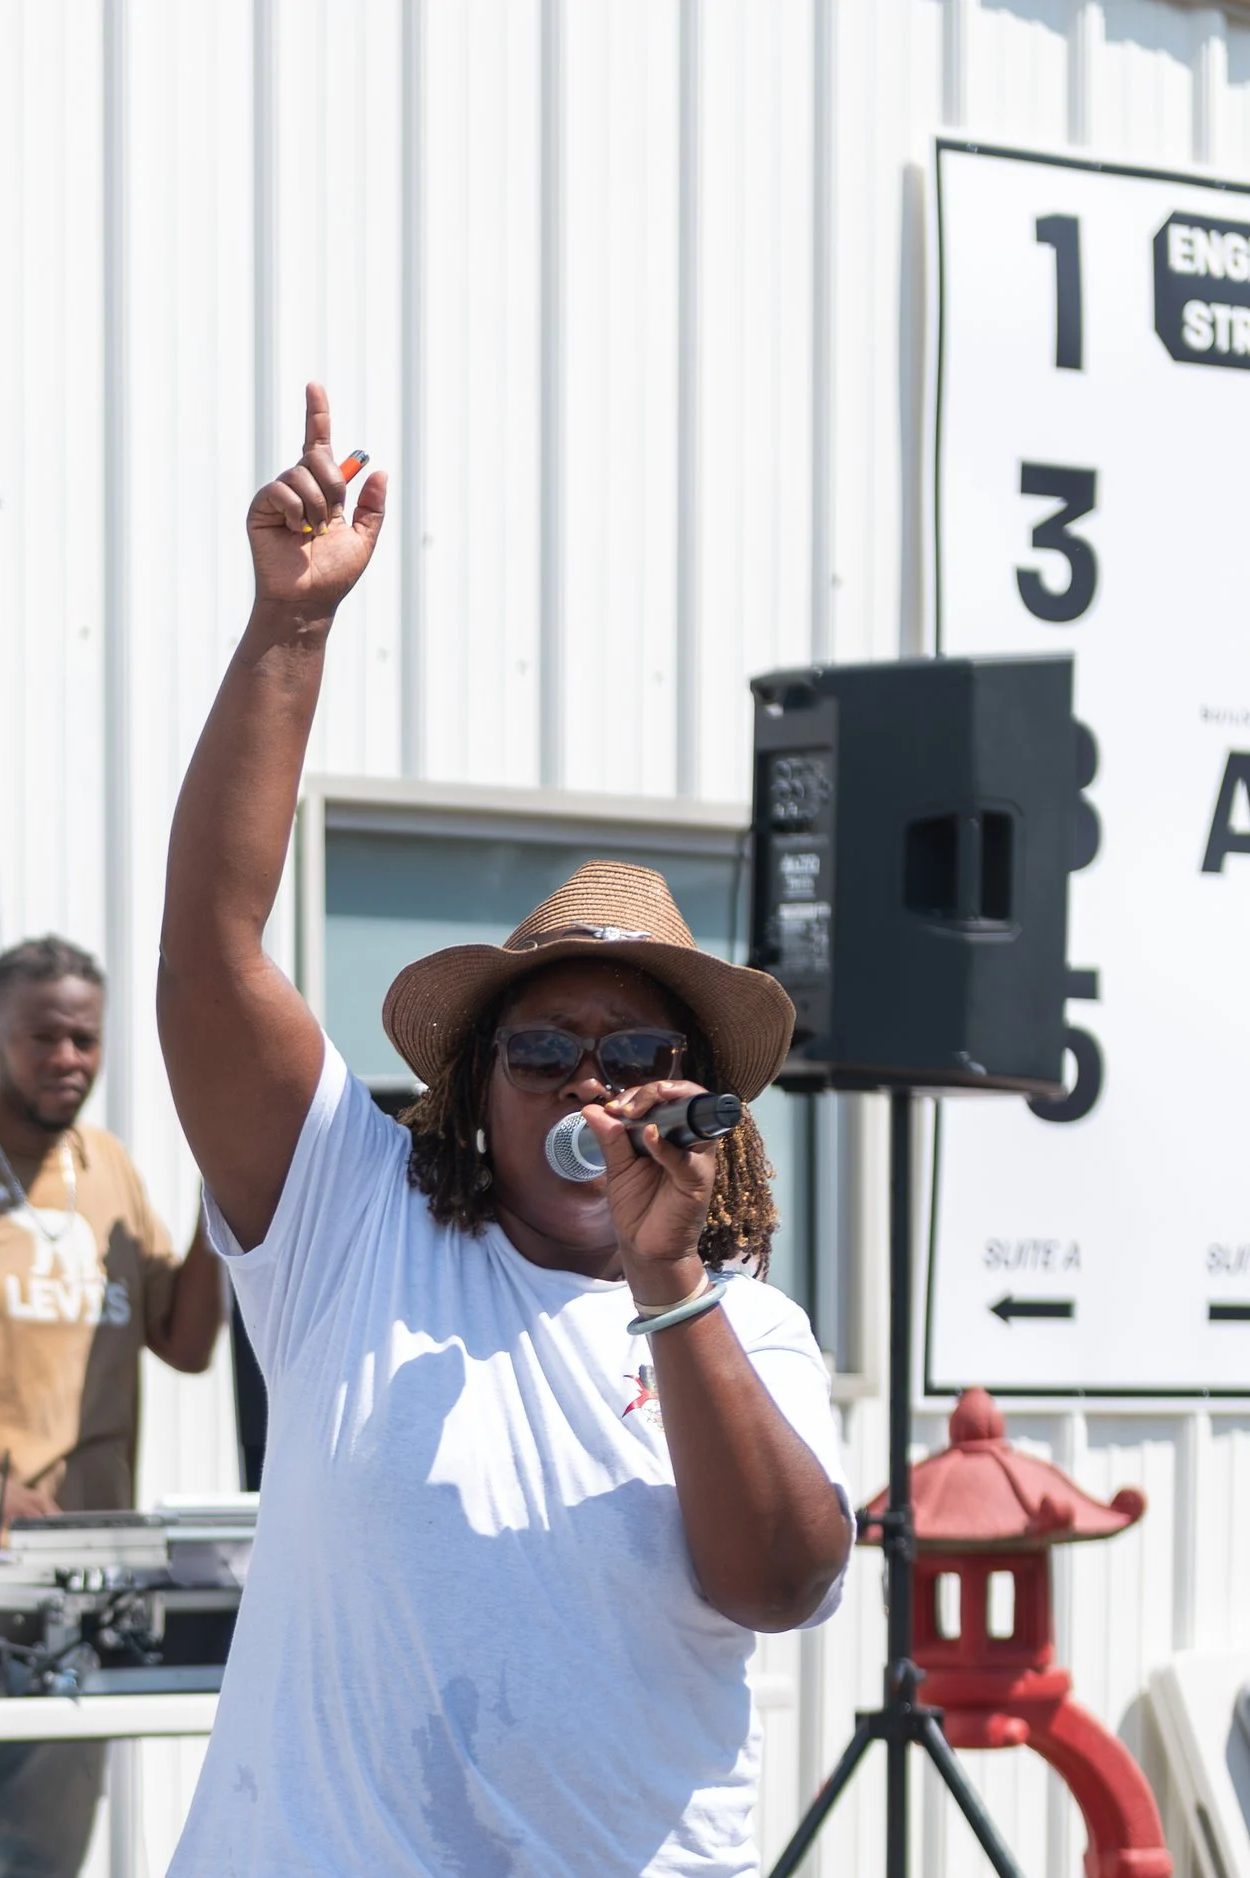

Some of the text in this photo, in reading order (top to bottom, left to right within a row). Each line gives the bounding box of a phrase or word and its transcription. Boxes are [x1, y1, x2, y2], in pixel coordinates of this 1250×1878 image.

[1035, 213, 1084, 370] 1
[1168, 222, 1250, 283] ENG
[1016, 460, 1099, 622] 3
